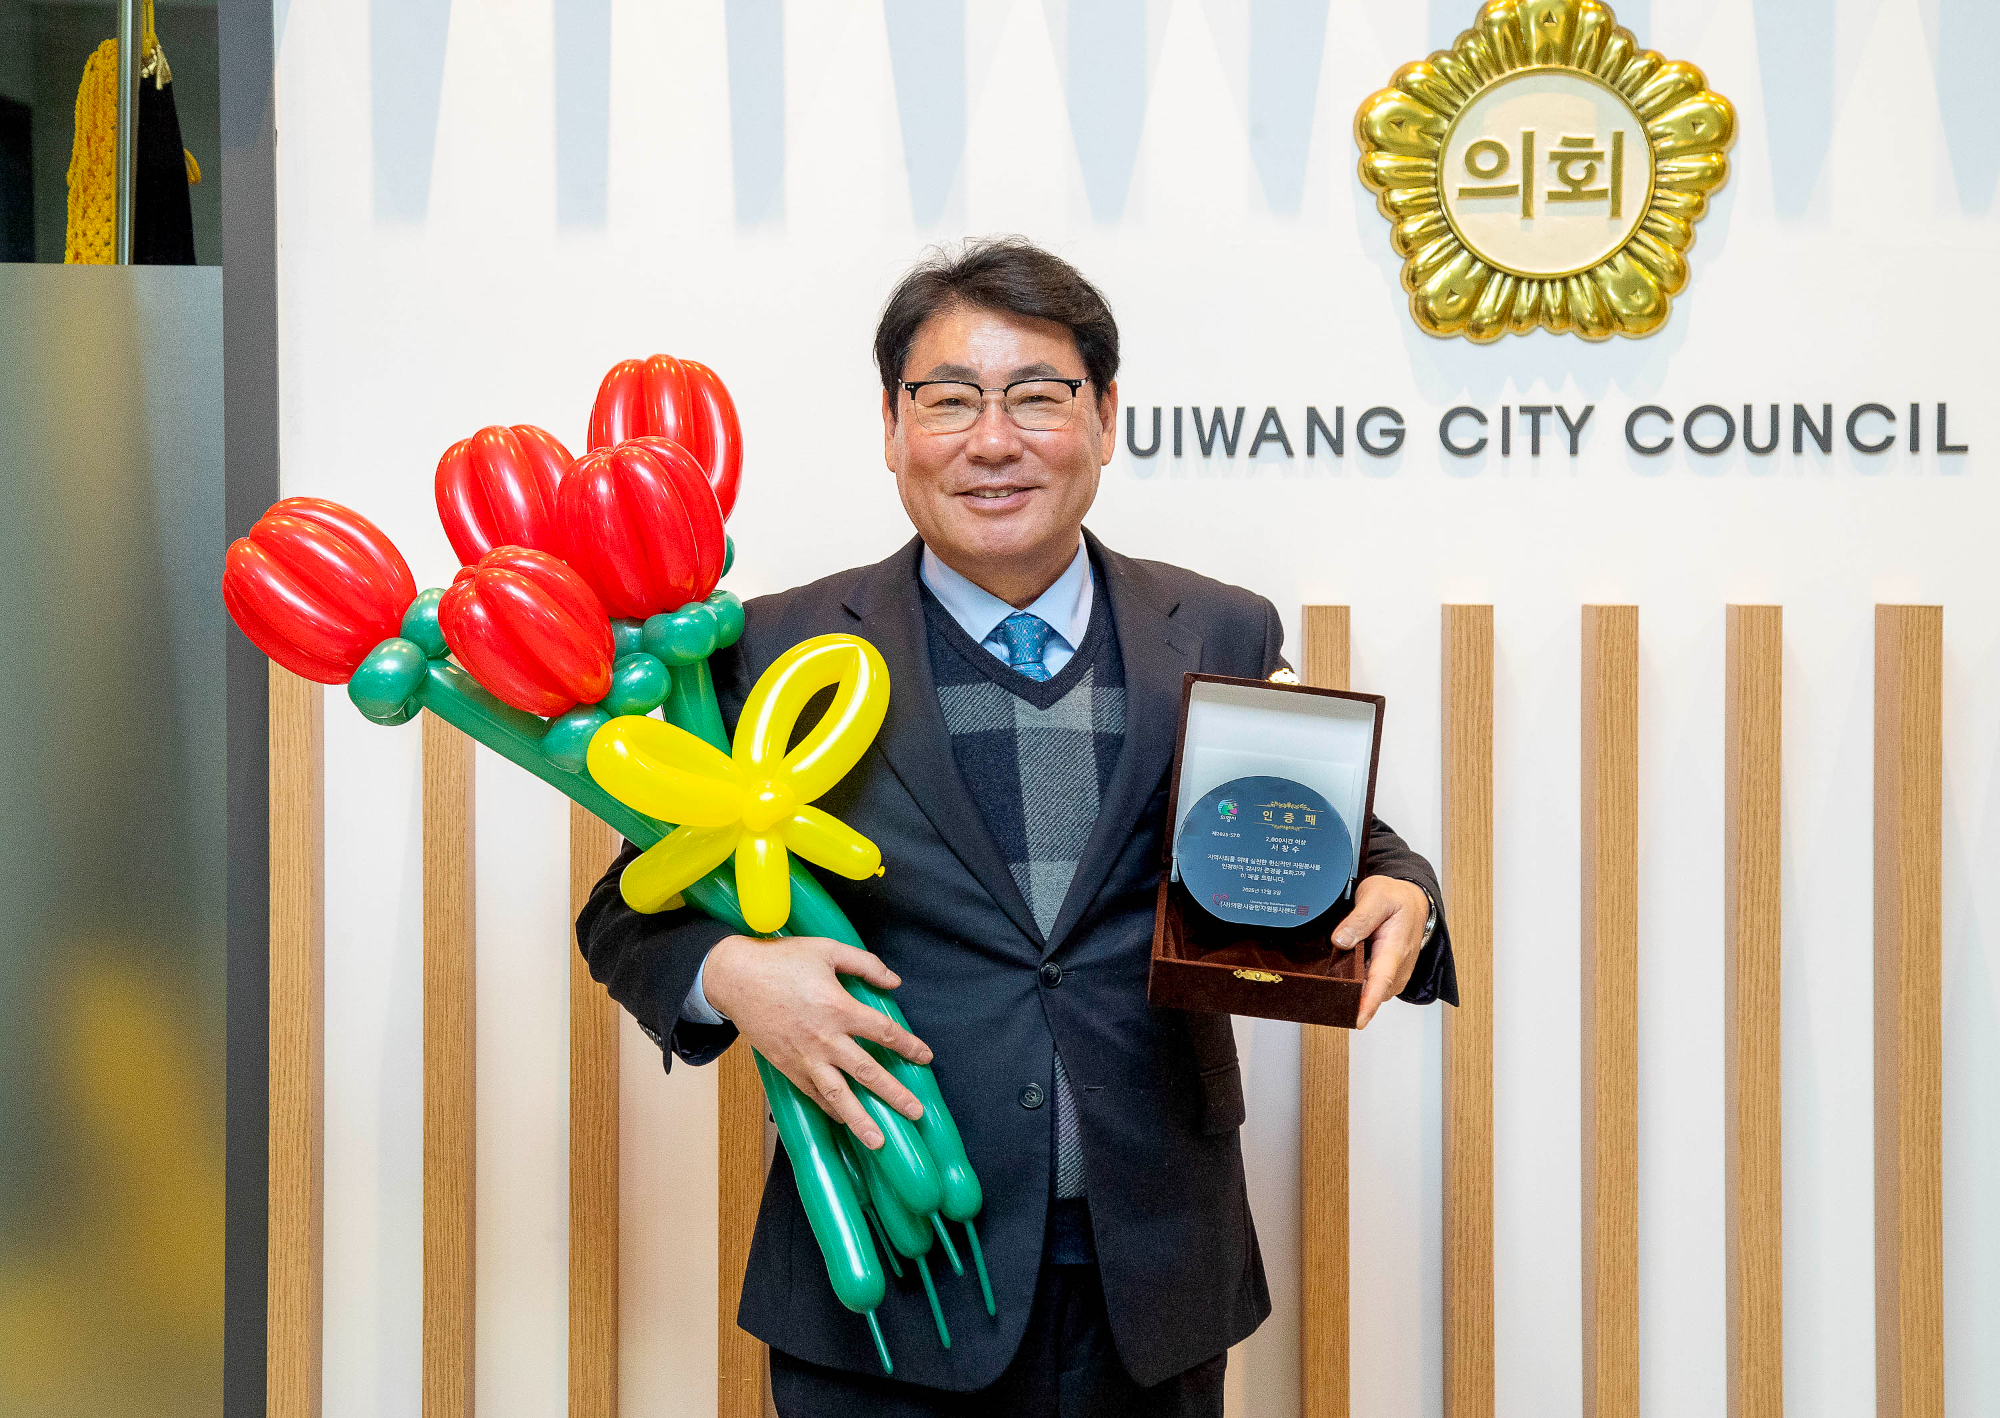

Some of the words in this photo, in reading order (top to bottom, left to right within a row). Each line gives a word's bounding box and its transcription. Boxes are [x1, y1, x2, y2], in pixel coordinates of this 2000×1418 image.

[1456, 129, 1625, 220] 의회
[1126, 406, 1406, 457] UIWANG
[1439, 405, 1594, 456] CITY
[1624, 403, 1969, 455] COUNCIL
